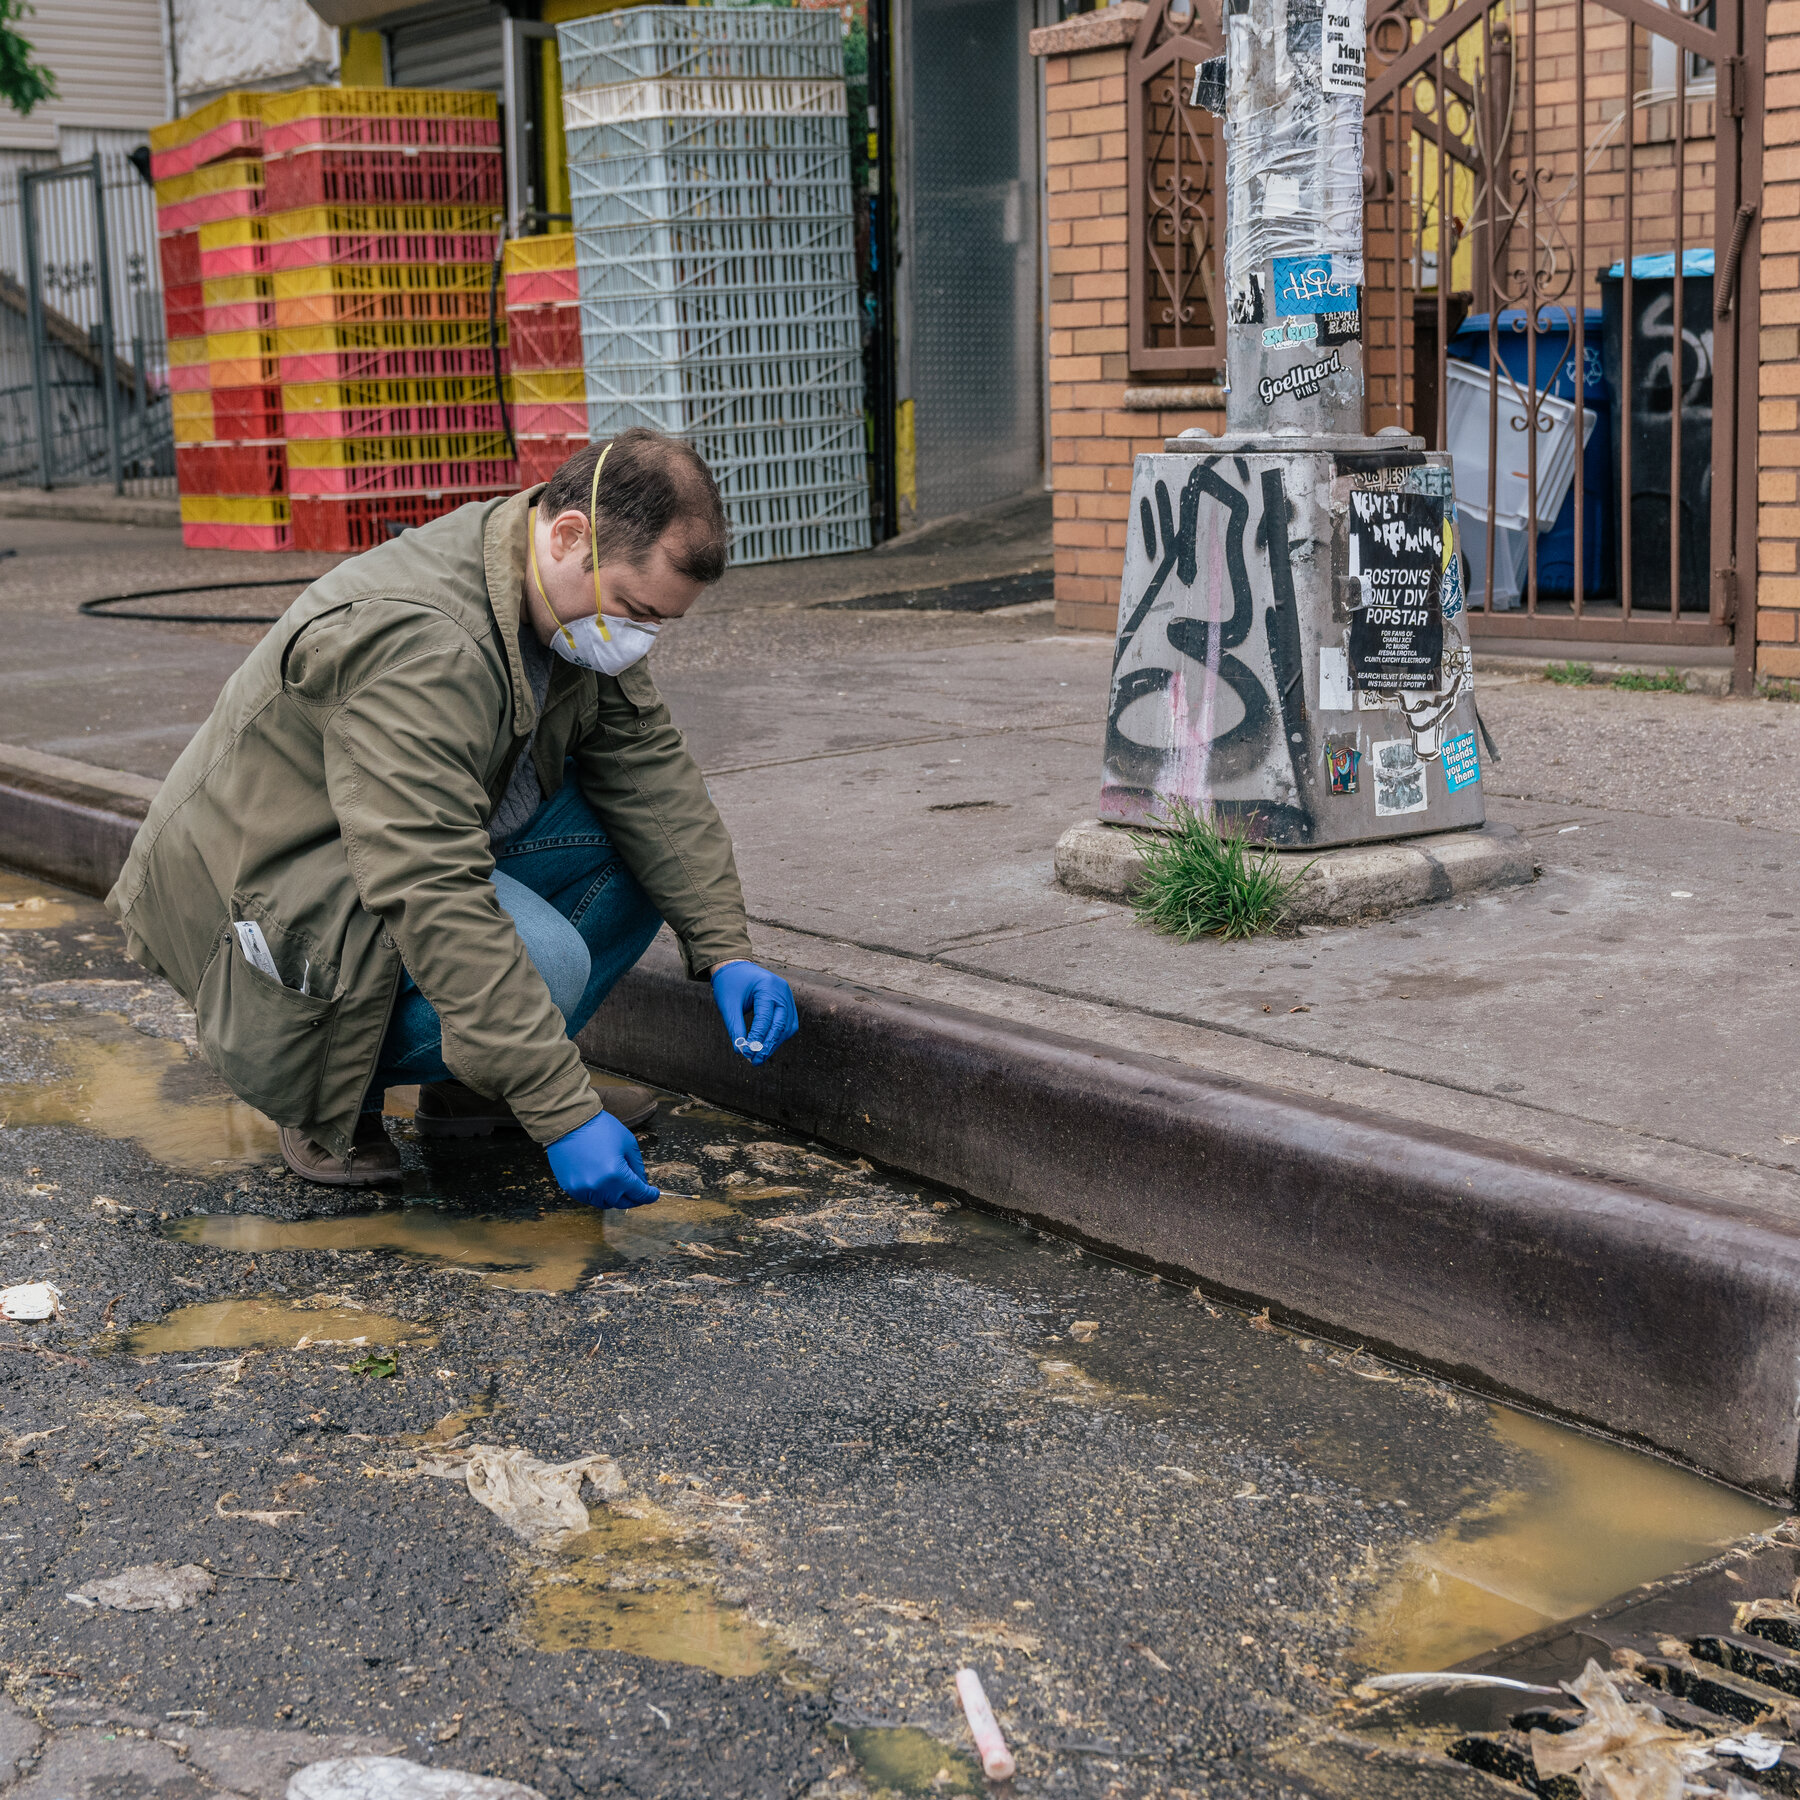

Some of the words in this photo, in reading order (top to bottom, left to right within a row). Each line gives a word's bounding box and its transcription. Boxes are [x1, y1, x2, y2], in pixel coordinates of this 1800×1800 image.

[1328, 14, 1350, 28] 7:00
[1338, 43, 1361, 64] May
[1263, 327, 1283, 346] IN
[1287, 323, 1317, 341] BLUE
[1260, 351, 1340, 404] Goellnerd
[1295, 382, 1318, 399] PINS
[1352, 491, 1399, 523] VELVET
[1373, 520, 1443, 558] DREAMING
[1364, 568, 1431, 586] BOSTON'S
[1403, 589, 1428, 607] DIY
[1365, 608, 1429, 627] POPSTAR
[1442, 741, 1456, 756] tell
[1456, 735, 1473, 752] your
[1446, 746, 1474, 765] friends
[1446, 764, 1460, 780] you
[1461, 756, 1478, 770] love
[1454, 769, 1475, 784] them
